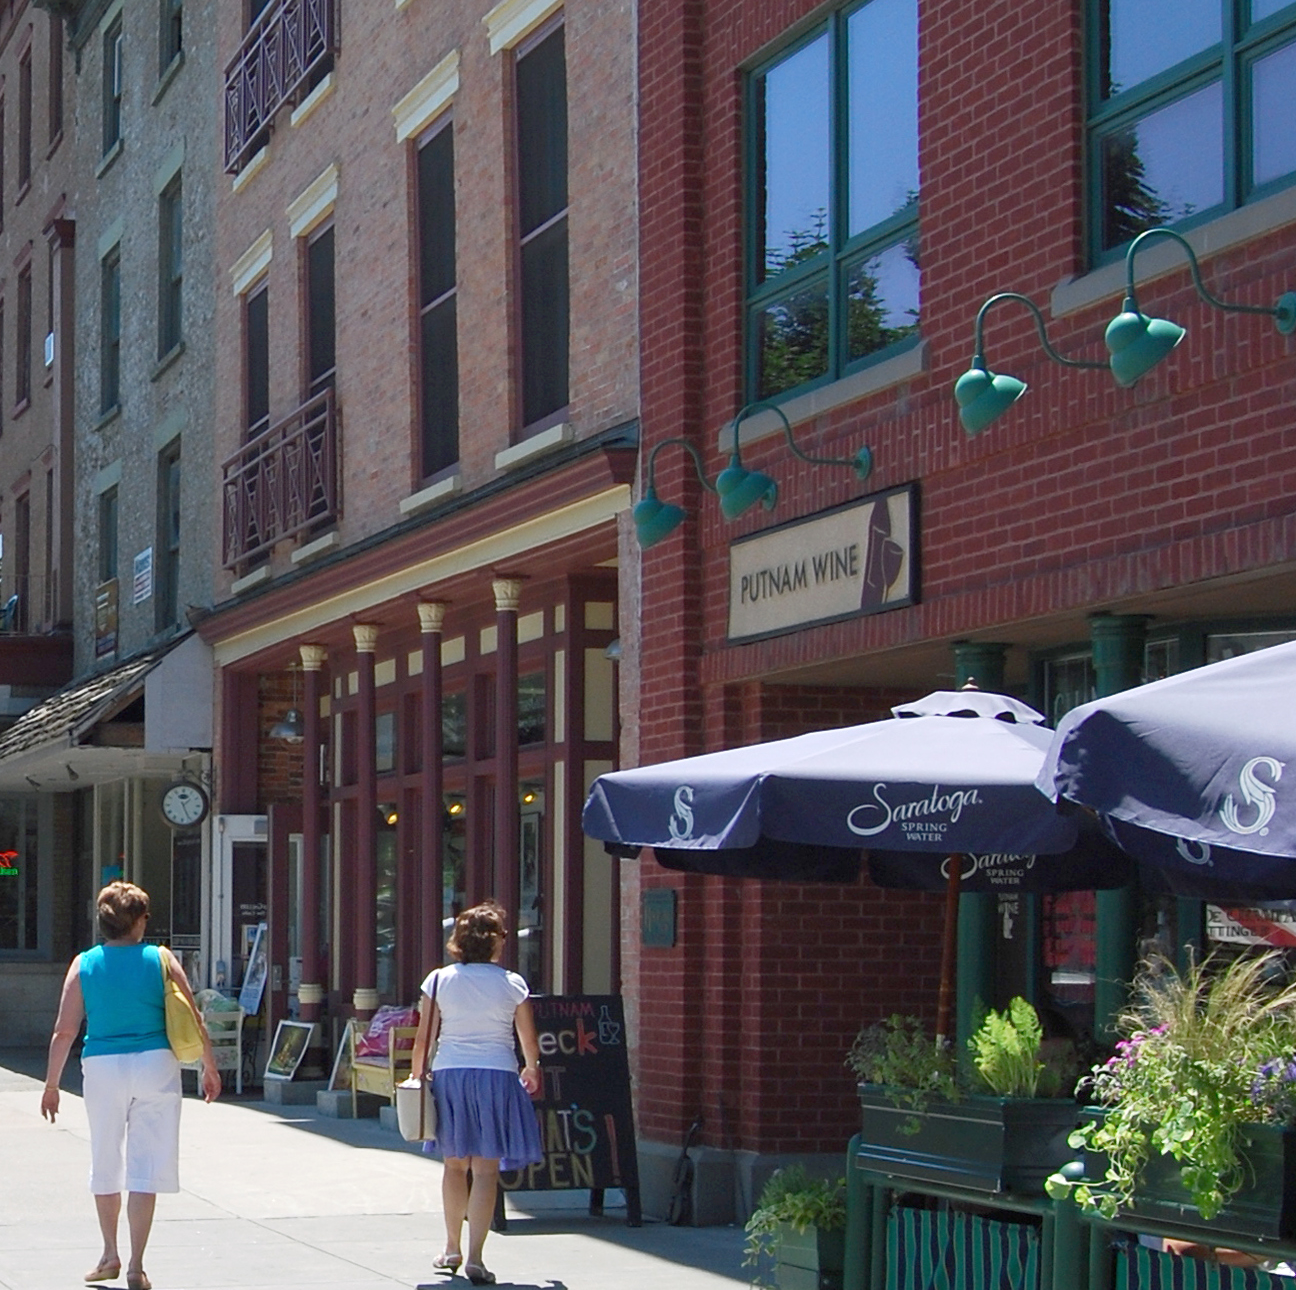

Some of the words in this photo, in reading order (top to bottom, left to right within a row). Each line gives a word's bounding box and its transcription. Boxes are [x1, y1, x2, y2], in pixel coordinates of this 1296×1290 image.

[741, 559, 808, 604] PUTNAM
[812, 545, 858, 584] WINE
[847, 783, 982, 836] Saratoga
[901, 822, 947, 832] SPRING
[906, 833, 942, 841] WATER
[985, 869, 1024, 877] SPRING
